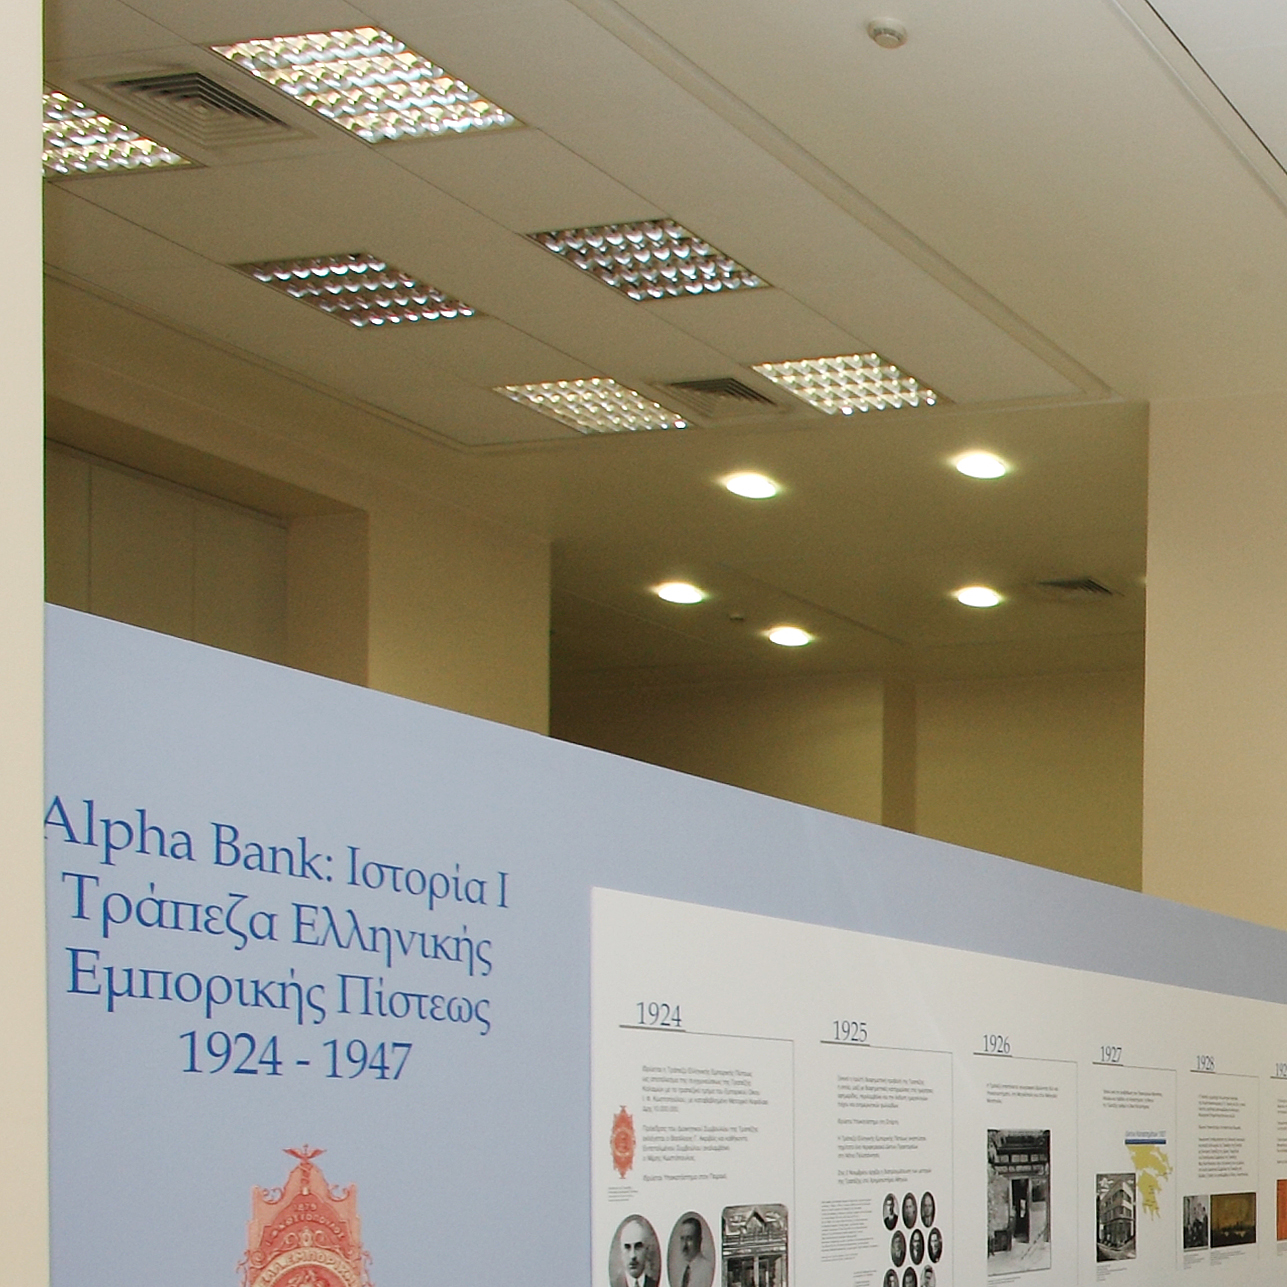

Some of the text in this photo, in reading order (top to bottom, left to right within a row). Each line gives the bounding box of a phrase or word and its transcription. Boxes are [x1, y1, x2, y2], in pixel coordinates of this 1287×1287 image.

[43, 794, 194, 868] Alpha
[210, 820, 334, 884] Bank:
[347, 845, 487, 909] Ιστορία
[61, 870, 493, 976] Τράπεζα Ελληνικής
[65, 946, 492, 1035] Εμπορικής Πίστεως
[636, 1001, 683, 1028] 1924
[832, 1019, 868, 1043] 1925
[983, 1034, 1011, 1054] 1926
[178, 1029, 283, 1077] 1924
[323, 1039, 413, 1081] 1947
[1100, 1046, 1122, 1063] 1927
[1196, 1055, 1215, 1071] 1928
